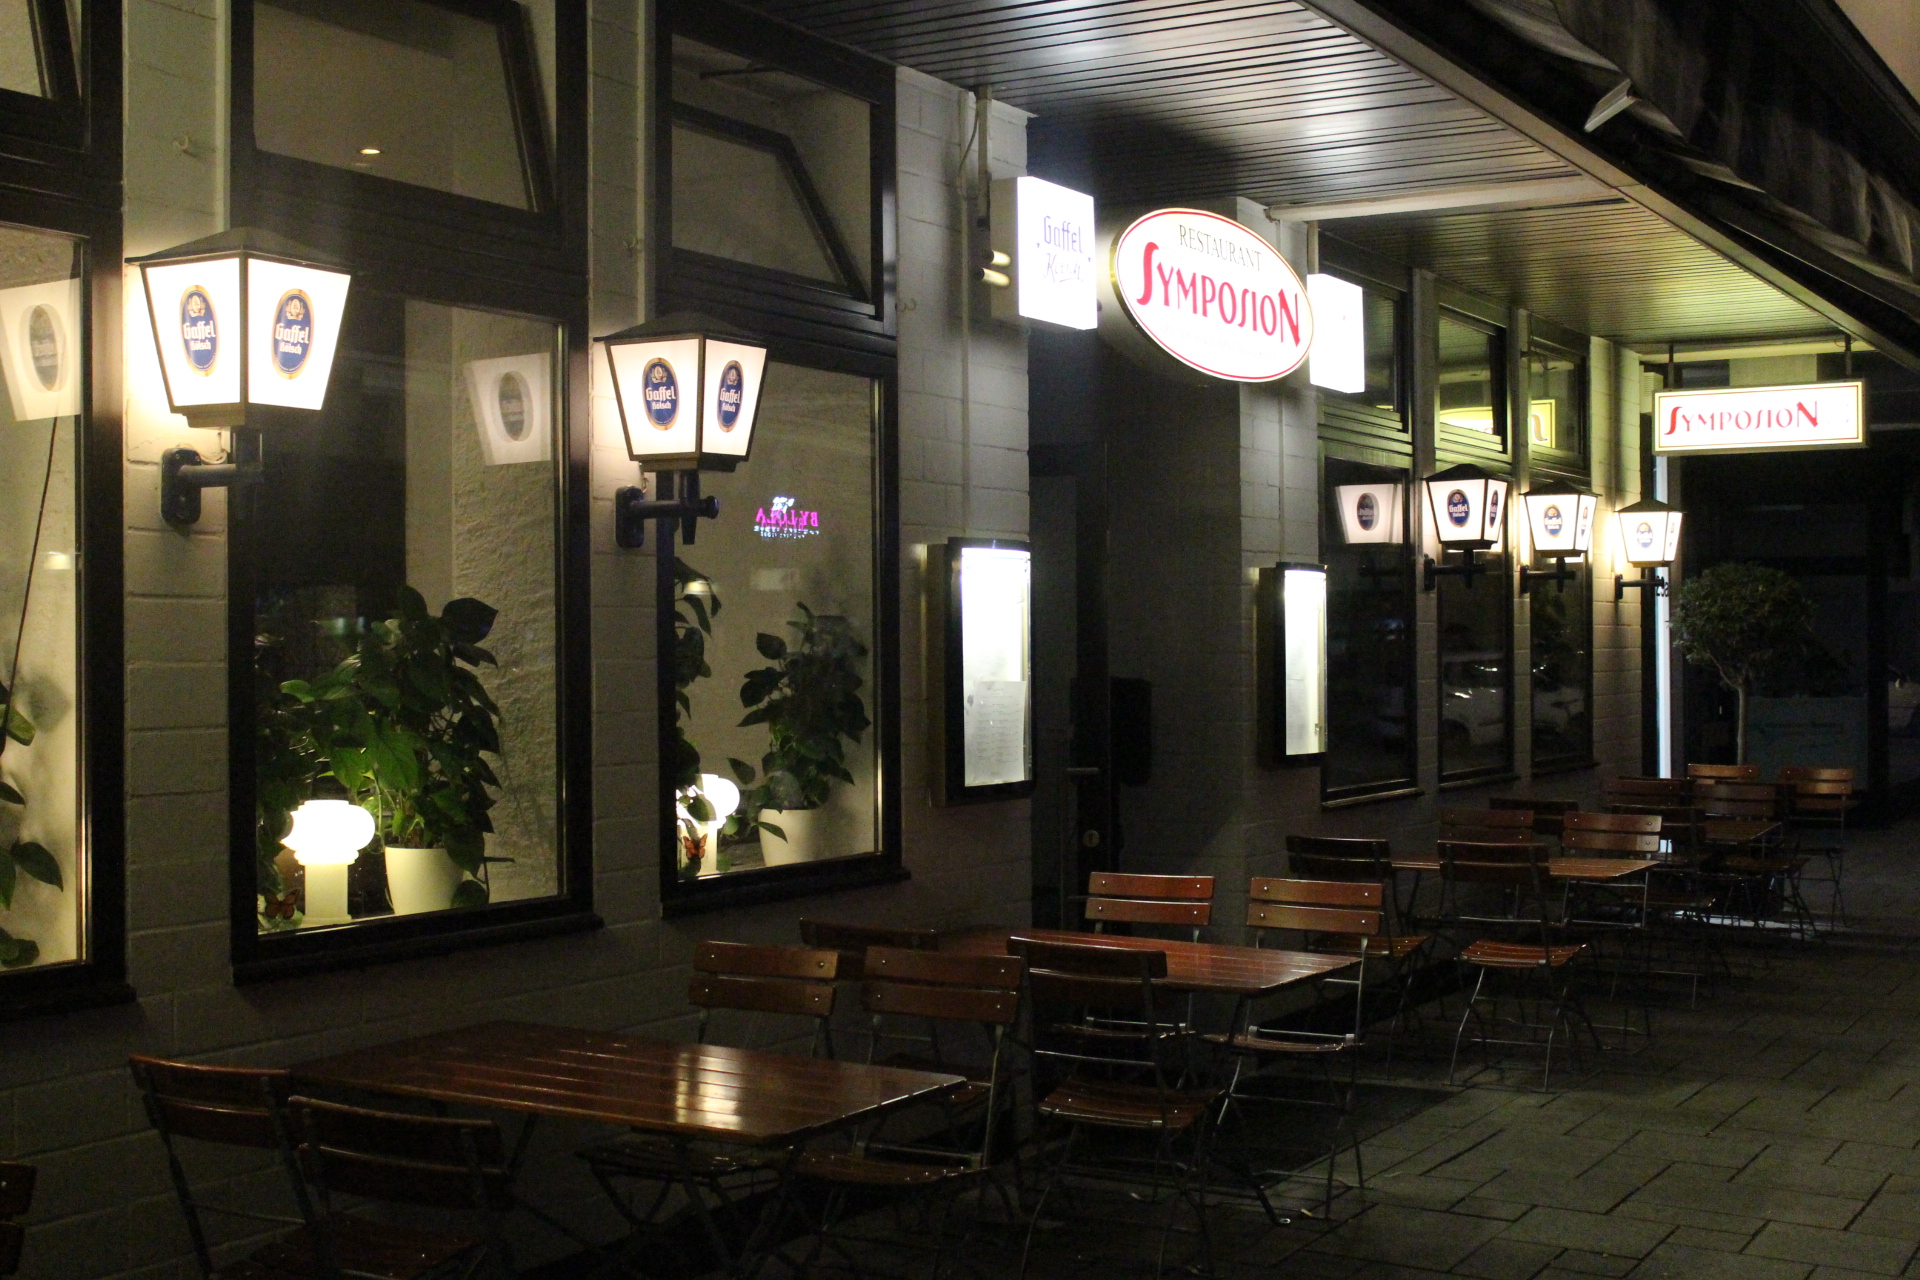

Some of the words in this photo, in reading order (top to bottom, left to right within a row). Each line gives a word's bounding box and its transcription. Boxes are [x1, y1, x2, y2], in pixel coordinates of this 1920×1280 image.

[1043, 215, 1083, 254] Gaffel
[1179, 224, 1262, 271] RESTAURANT
[1136, 241, 1301, 348] SYMPOSION
[183, 320, 216, 340] Gaffel
[275, 322, 310, 344] Gaffel
[645, 385, 676, 401] Gaffel
[720, 387, 741, 404] Gaffel
[1663, 400, 1819, 436] SYMPOSION
